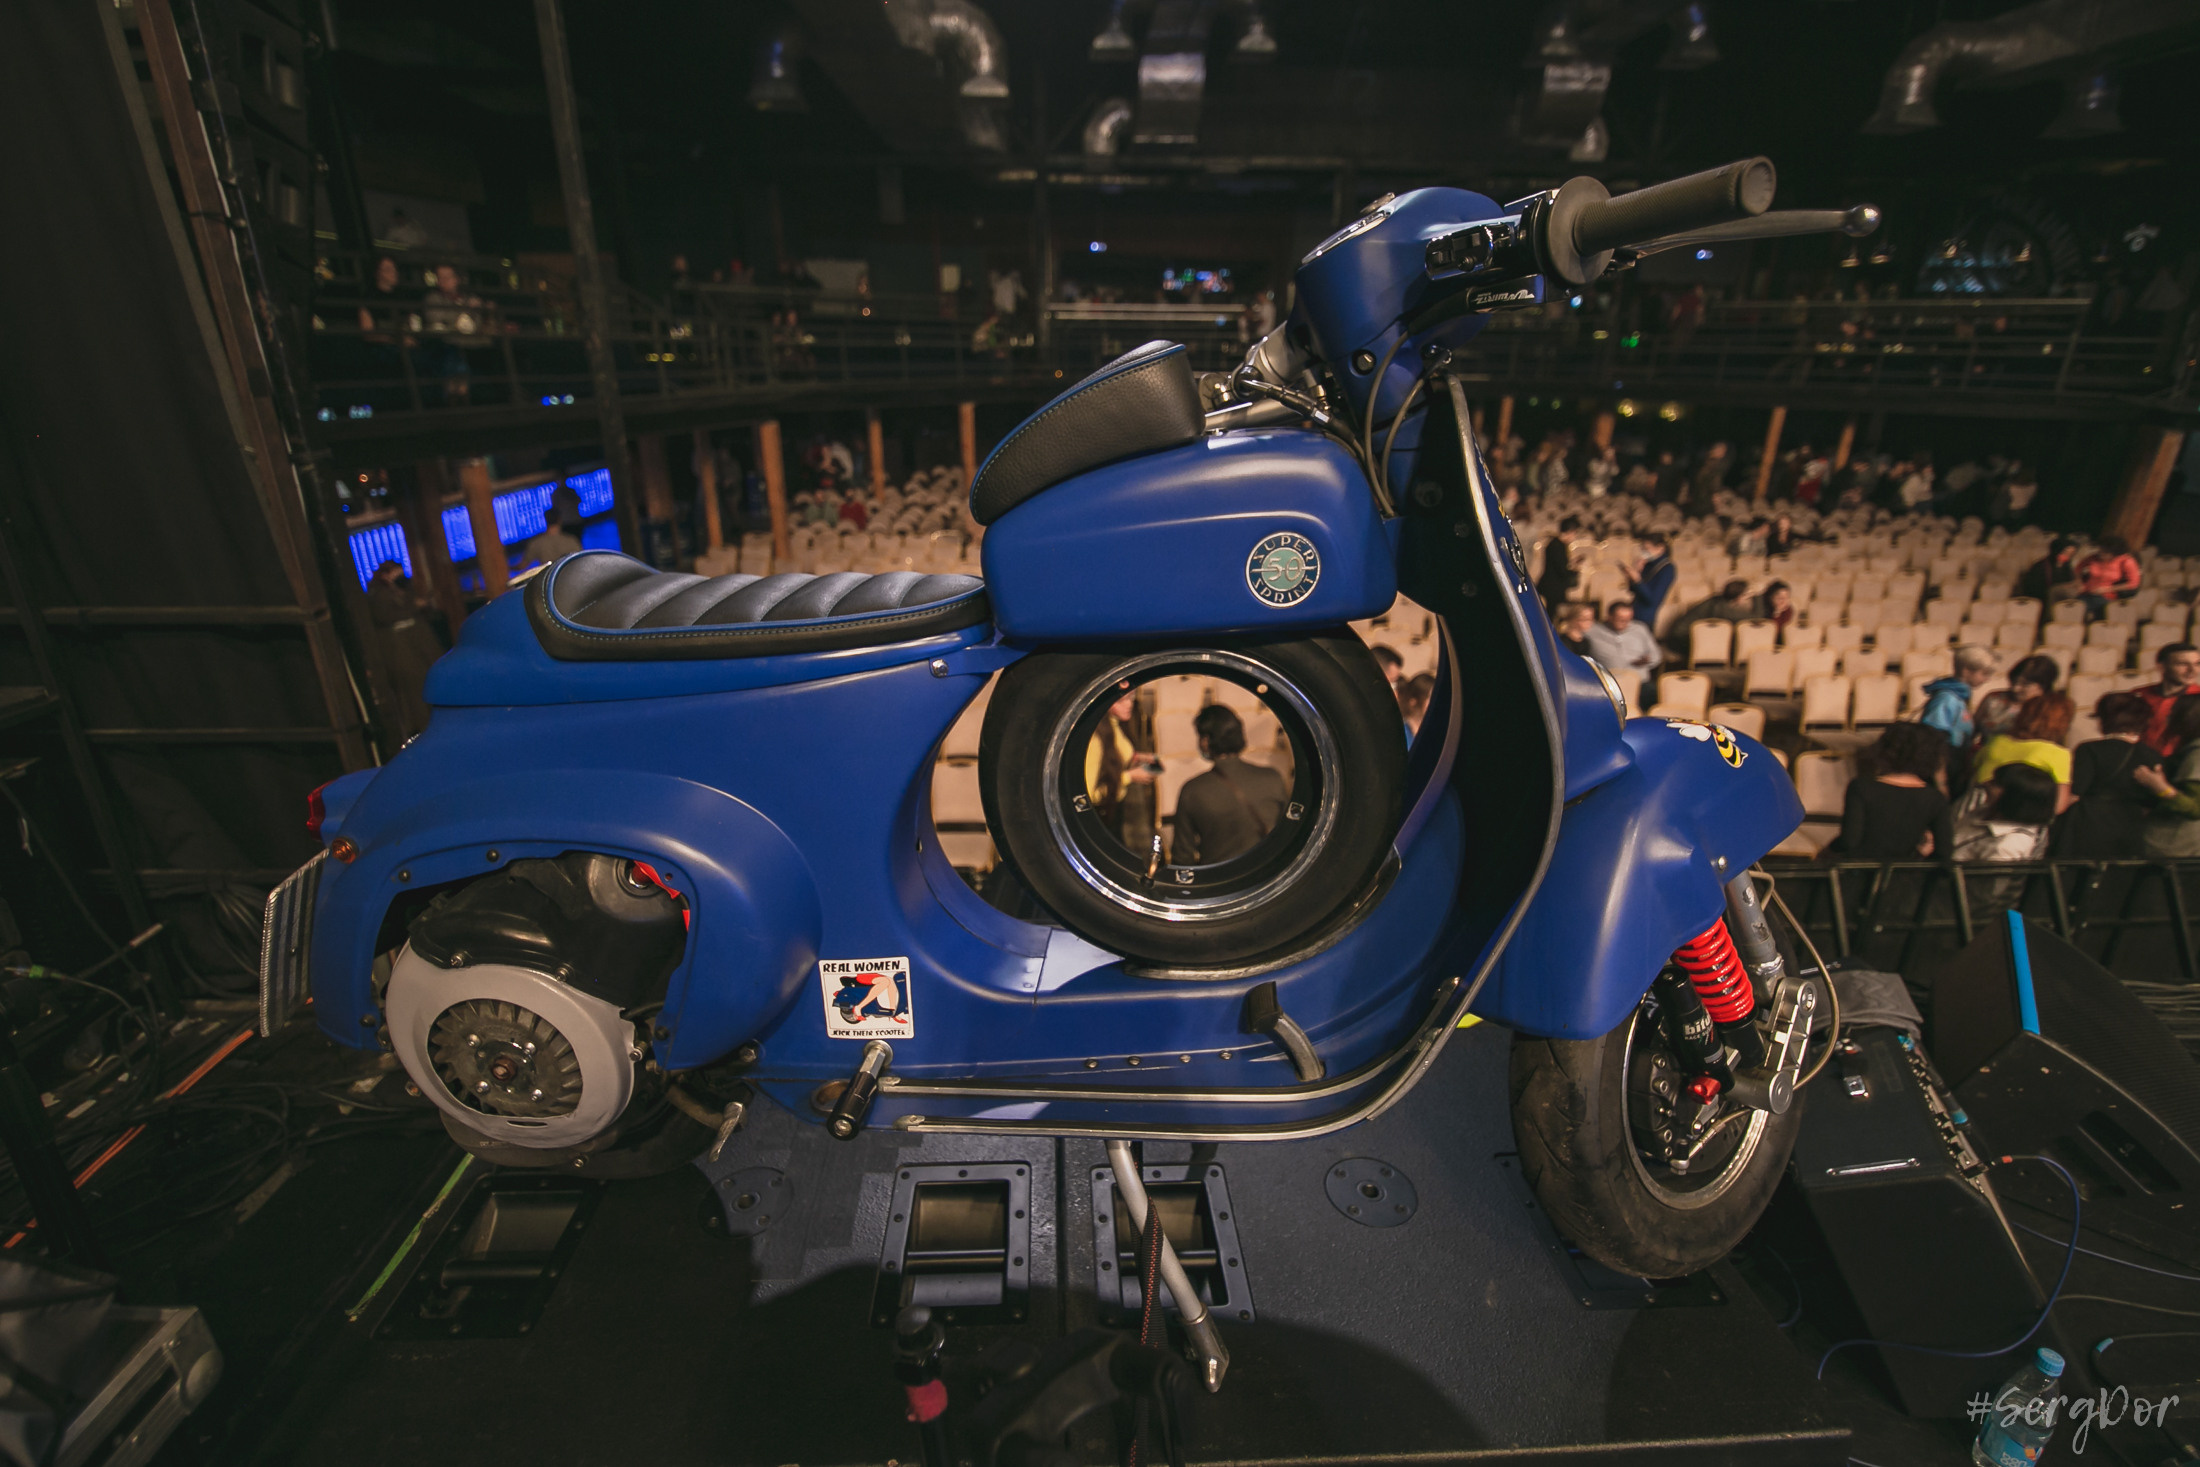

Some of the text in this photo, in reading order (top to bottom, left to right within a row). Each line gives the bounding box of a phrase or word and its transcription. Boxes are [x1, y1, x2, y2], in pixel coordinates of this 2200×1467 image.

[1253, 535, 1315, 563] SUPER
[1267, 556, 1303, 582] 50
[1252, 574, 1314, 603] SPRINT
[823, 962, 851, 973] REAL
[832, 1029, 851, 1037] KICK
[852, 1029, 874, 1037] THEIR
